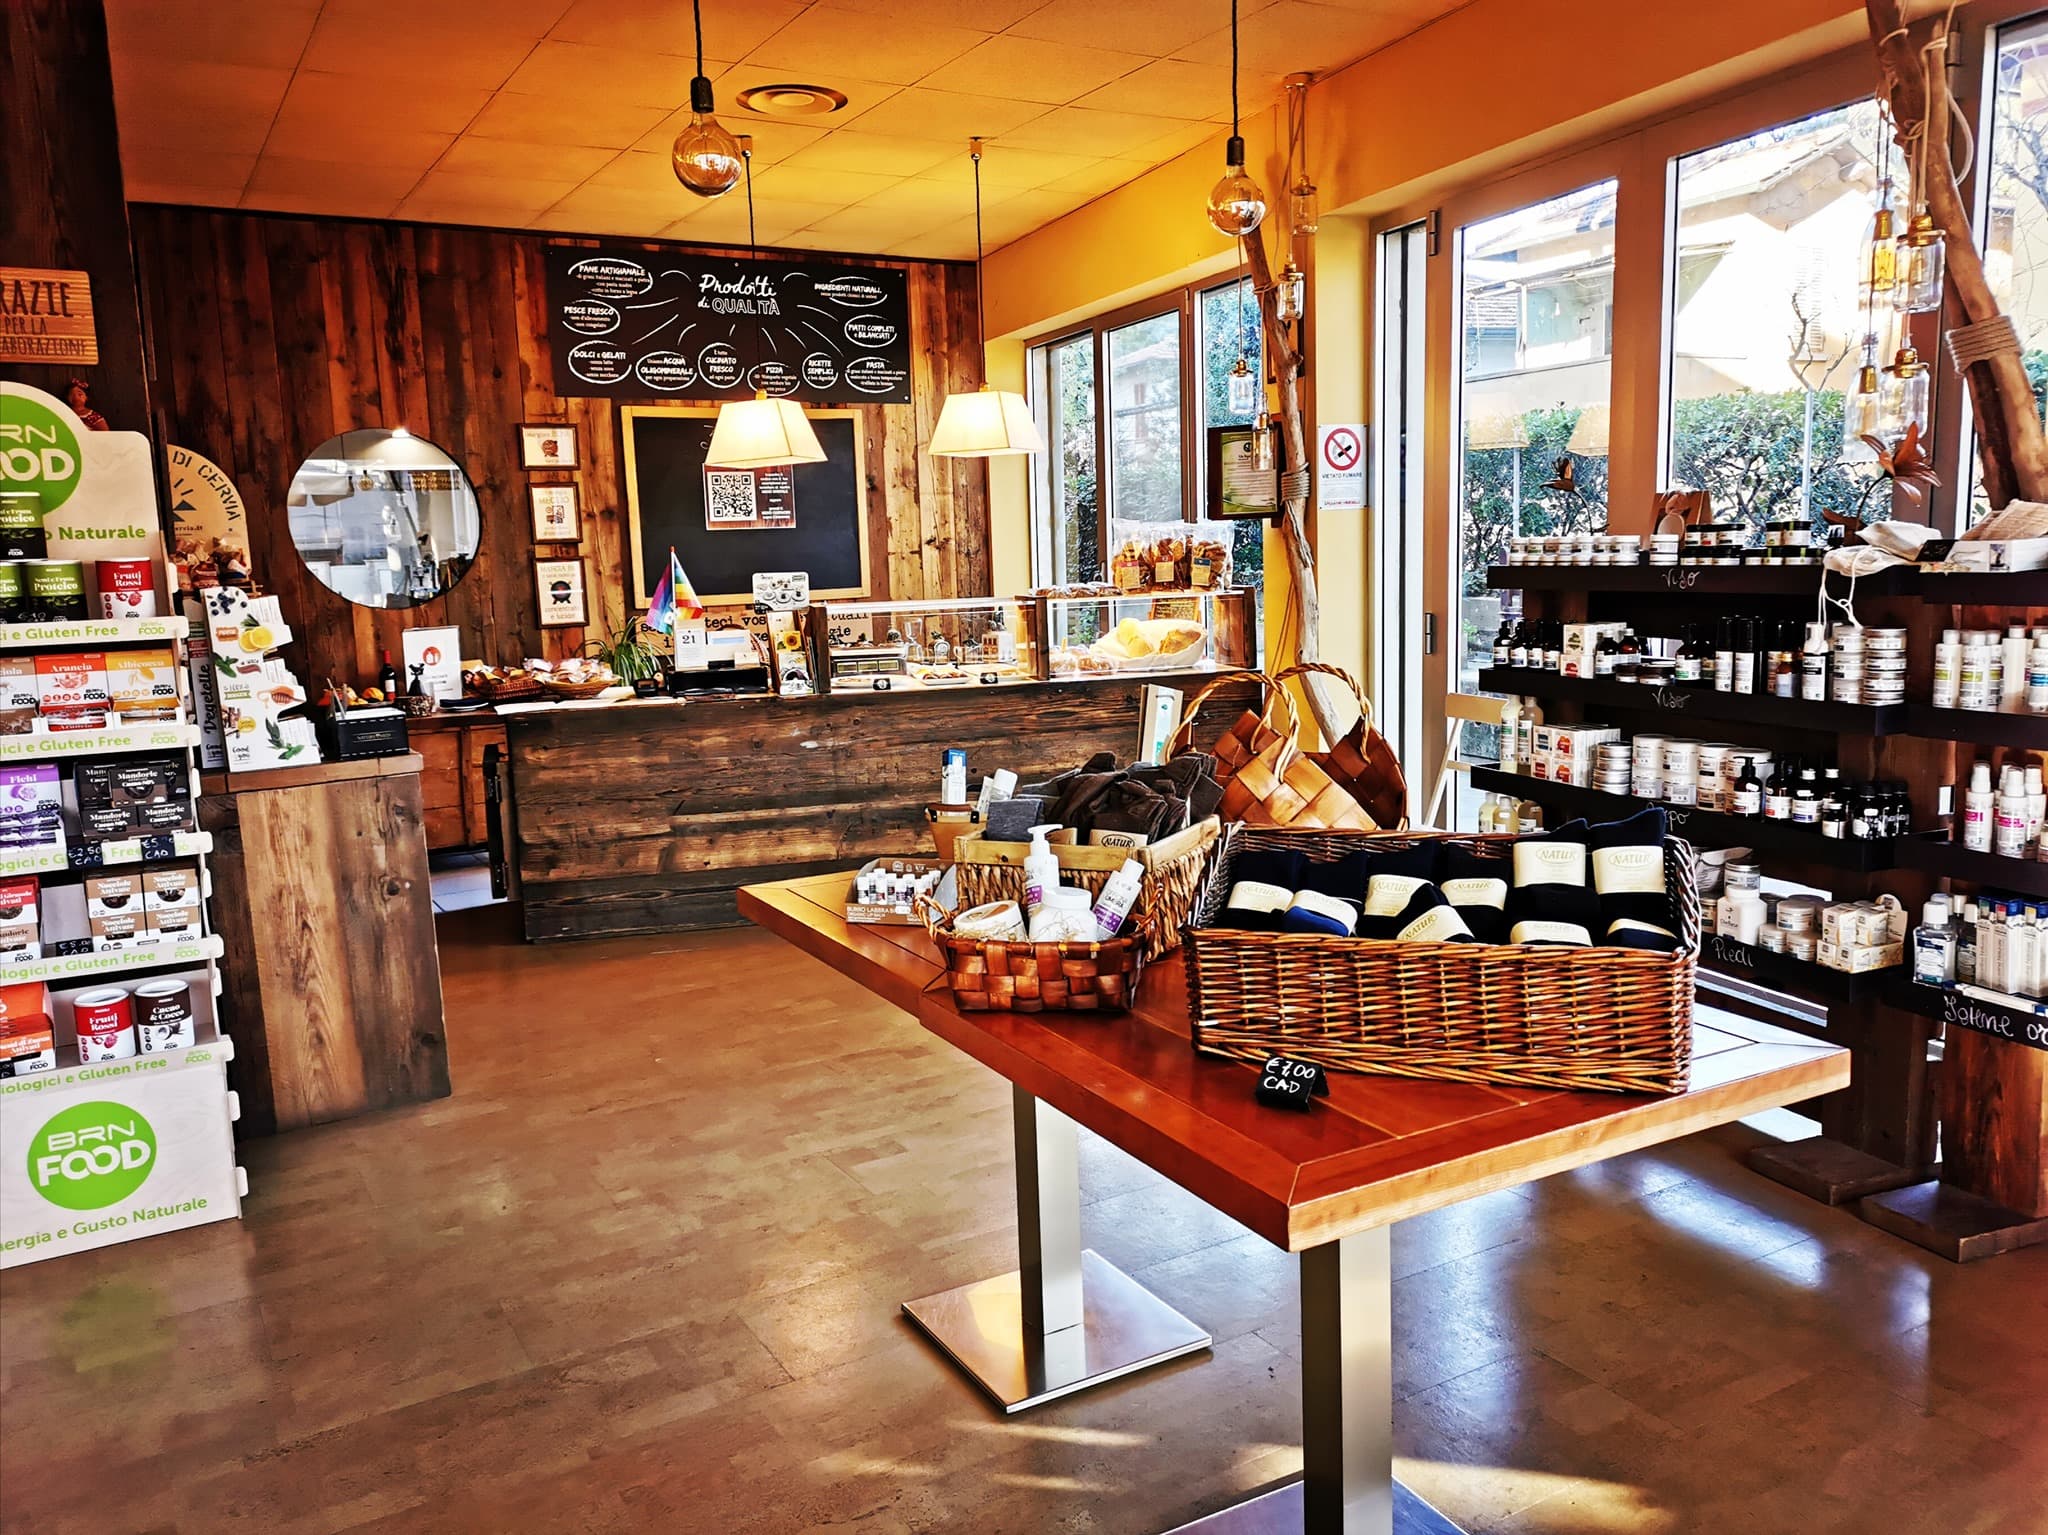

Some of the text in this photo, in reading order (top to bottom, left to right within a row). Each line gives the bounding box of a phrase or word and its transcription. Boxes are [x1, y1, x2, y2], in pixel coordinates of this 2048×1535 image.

[579, 265, 646, 276] PANE ARTIGIANALE
[814, 283, 851, 292] INGREDIENTI
[697, 296, 710, 308] di
[564, 306, 615, 316] PESCE FRESCO
[4, 316, 48, 335] PER LA
[848, 324, 895, 333] PIATTI COMPLETI
[858, 331, 891, 339] BILANCIATI
[574, 351, 595, 359] DOLCI
[601, 352, 626, 360] GELATI
[705, 356, 737, 364] CUCINATO
[664, 357, 686, 366] ACQUA
[866, 361, 885, 369] PASTA
[709, 365, 734, 373] FRESCO
[808, 367, 834, 375] SEMPLICI
[173, 451, 241, 521] DI CERVIA
[58, 525, 147, 541] Naturale
[113, 571, 142, 581] Frutti
[34, 582, 79, 592] Proteico
[115, 578, 142, 587] Rossi
[12, 631, 21, 640] e
[25, 626, 81, 640] Gluten
[86, 625, 119, 637] Free
[682, 635, 696, 644] 21
[50, 663, 93, 673] Arancia
[27, 743, 35, 752] e
[39, 737, 97, 752] Gluten
[99, 735, 132, 748] Free
[117, 770, 158, 780] Mandorle
[89, 811, 131, 820] Mandorle
[145, 806, 185, 816] Mandorle
[1104, 837, 1132, 848] NATUR
[1541, 849, 1576, 860] NATUR
[1614, 854, 1650, 865] NATUR
[40, 857, 48, 866] e
[1405, 914, 1437, 940] NATUR
[1711, 937, 1754, 968] Piedi
[53, 963, 61, 974] e
[65, 956, 119, 972] Gluten
[123, 951, 156, 964] Free
[152, 1004, 181, 1014] Cacao
[158, 1009, 185, 1020] Cocco
[91, 1020, 118, 1032] Rossi
[65, 1074, 75, 1084] e
[78, 1064, 132, 1082] Gluten
[135, 1058, 168, 1072] Free
[1263, 1076, 1300, 1094] CAD
[48, 1120, 135, 1152] BRN
[37, 1139, 151, 1187] FOOD
[56, 1228, 68, 1239] e
[73, 1217, 128, 1236] Gusto
[133, 1198, 208, 1224] Naturale
